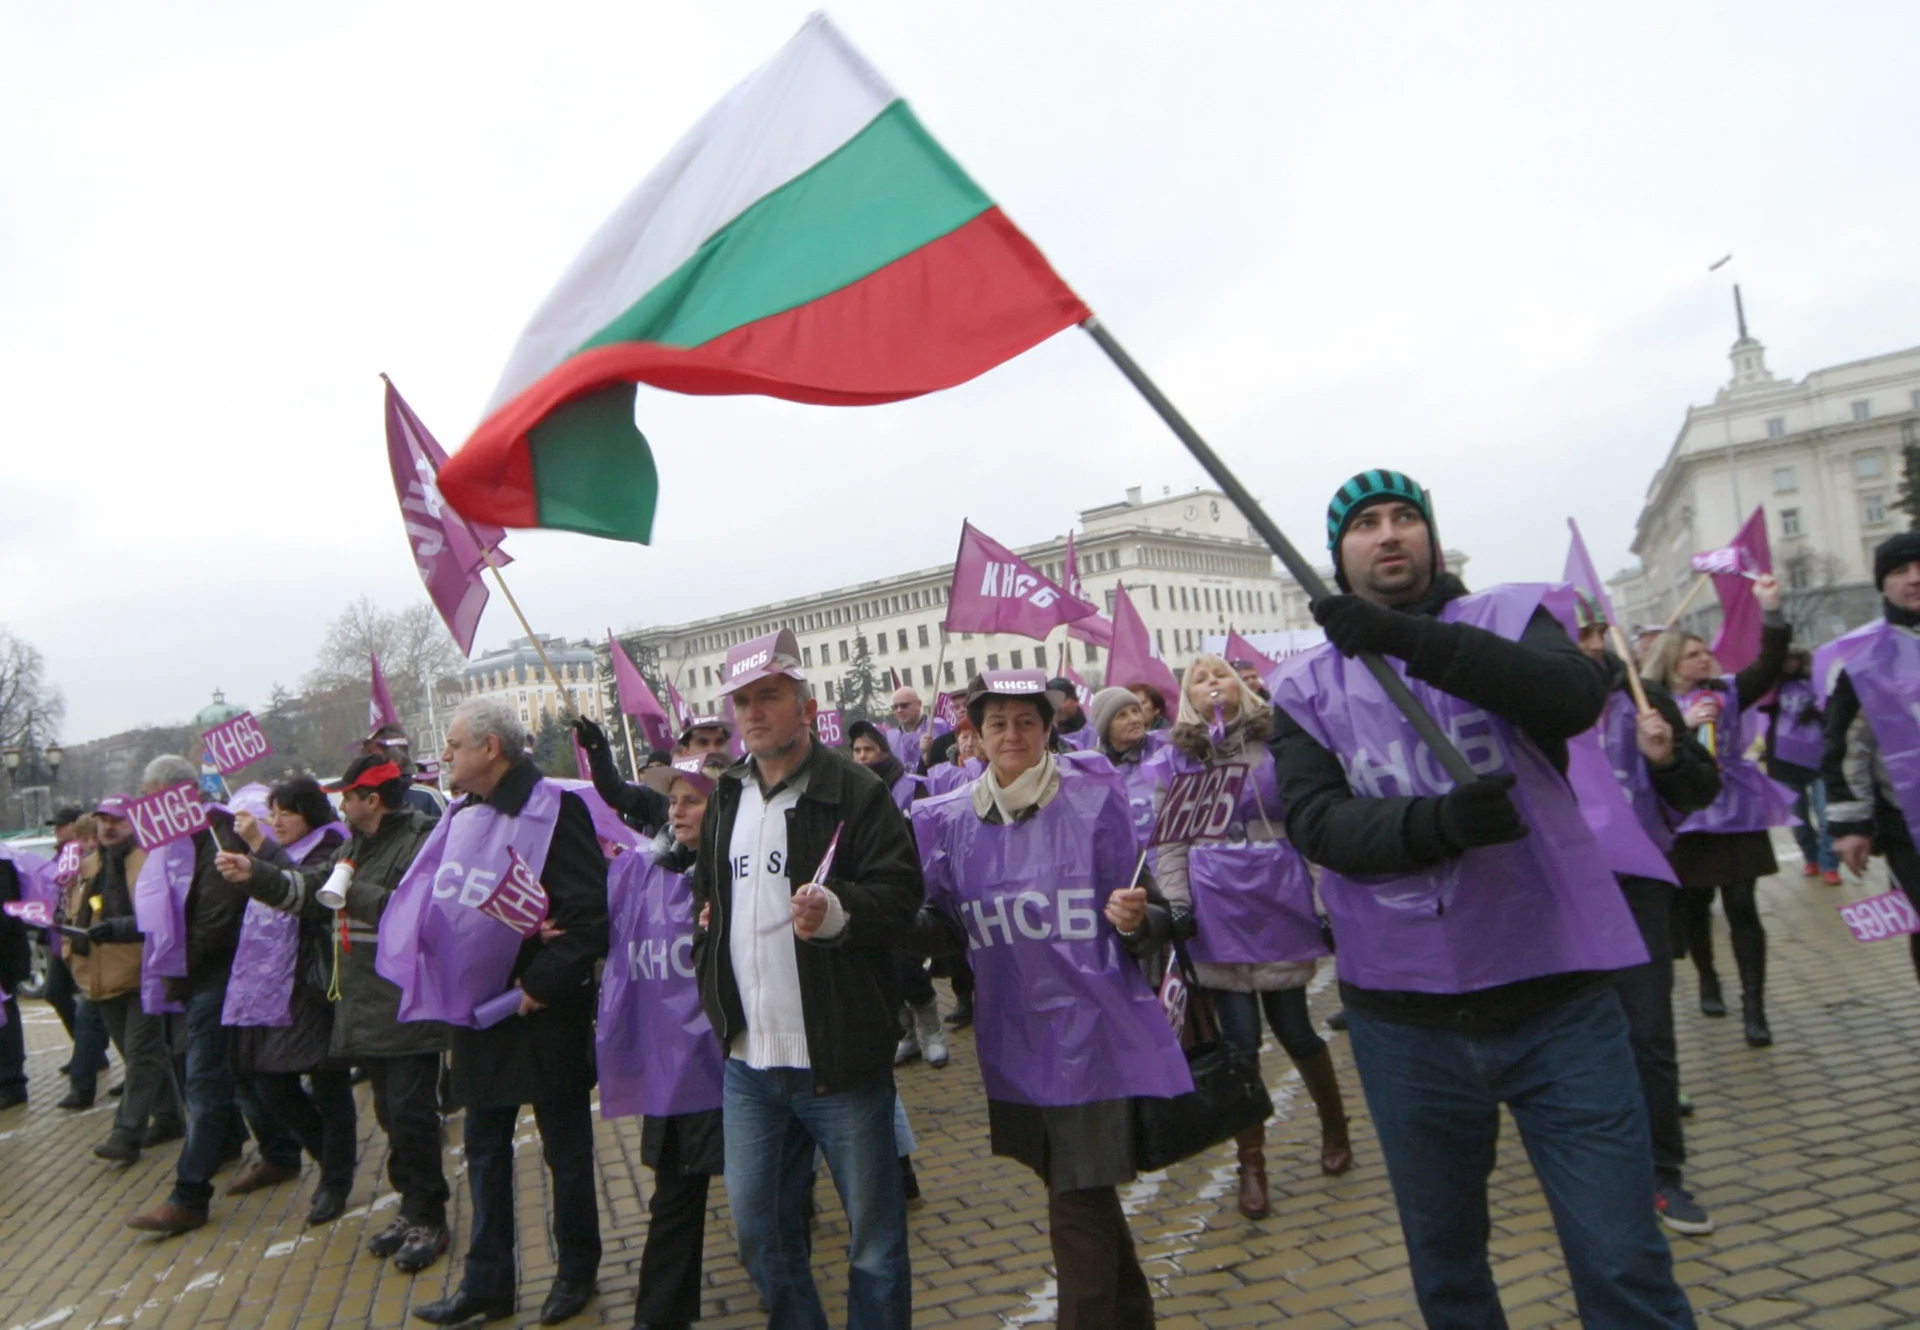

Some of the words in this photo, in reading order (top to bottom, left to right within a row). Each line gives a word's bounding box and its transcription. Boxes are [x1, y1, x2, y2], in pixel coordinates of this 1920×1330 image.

[980, 561, 1060, 608] КНСБ
[732, 650, 768, 678] КНСБ
[993, 680, 1039, 691] КНСБ
[204, 715, 267, 771] КНСБ
[127, 784, 206, 848] КНСБ
[1152, 766, 1245, 841] КНСБ
[483, 852, 546, 935] КНС
